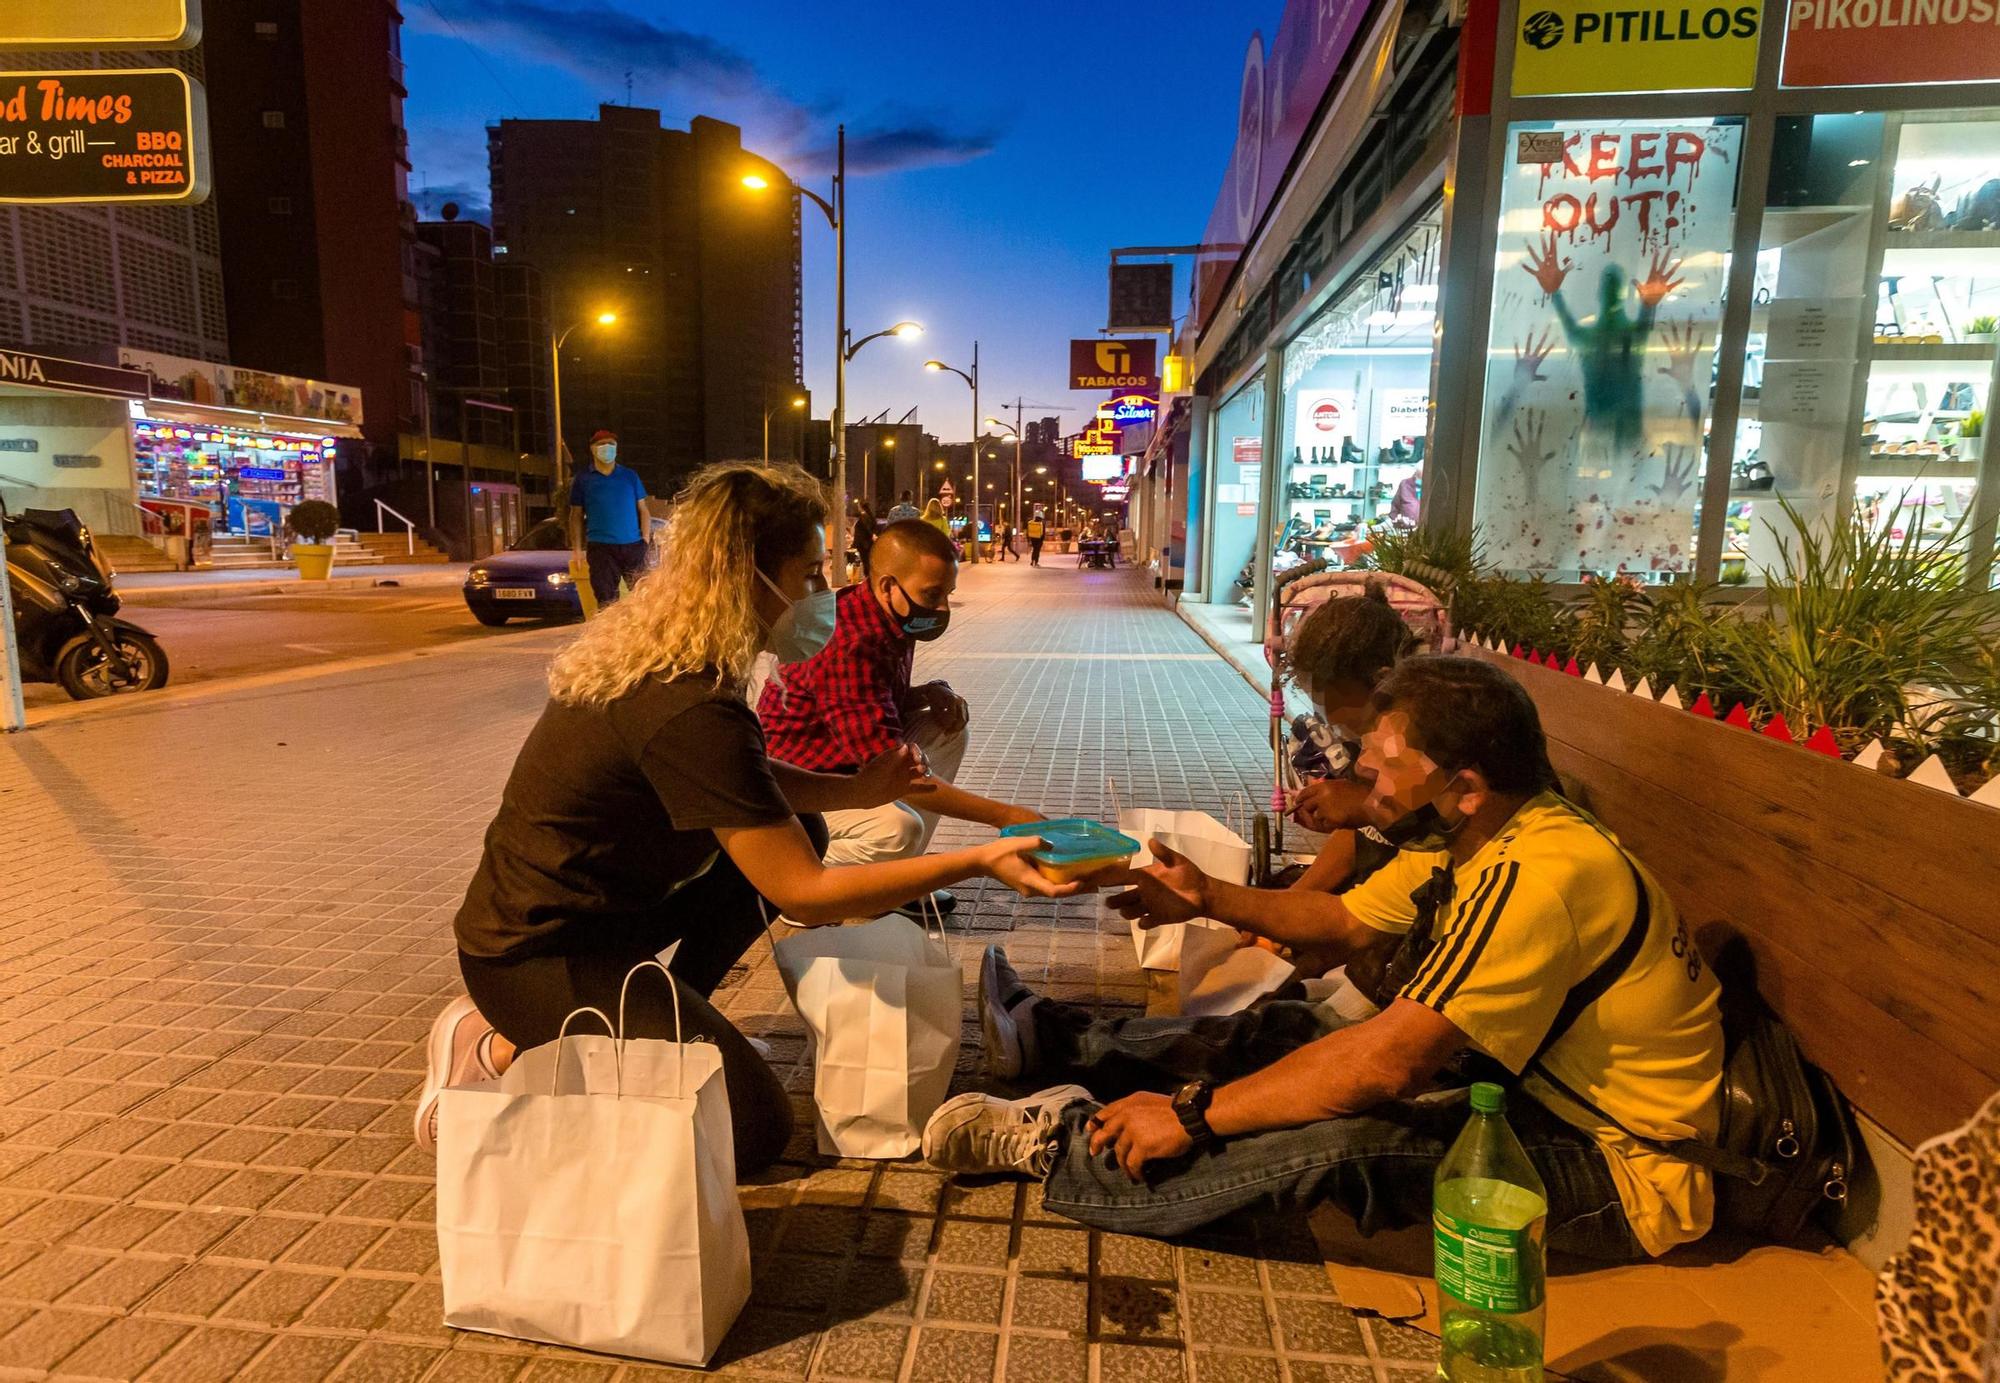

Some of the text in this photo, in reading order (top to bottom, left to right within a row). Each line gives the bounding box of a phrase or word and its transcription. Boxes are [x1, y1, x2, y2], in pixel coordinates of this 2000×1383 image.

[1573, 6, 1758, 44] PITILLOS
[0, 79, 132, 124] d Times
[26, 130, 43, 154] &
[48, 130, 86, 160] grill
[136, 131, 182, 150] BBQ
[102, 153, 183, 168] CHARCOAL
[126, 170, 184, 184] & PIZZA
[0, 353, 46, 382] NIA
[1077, 376, 1148, 387] TABACOS
